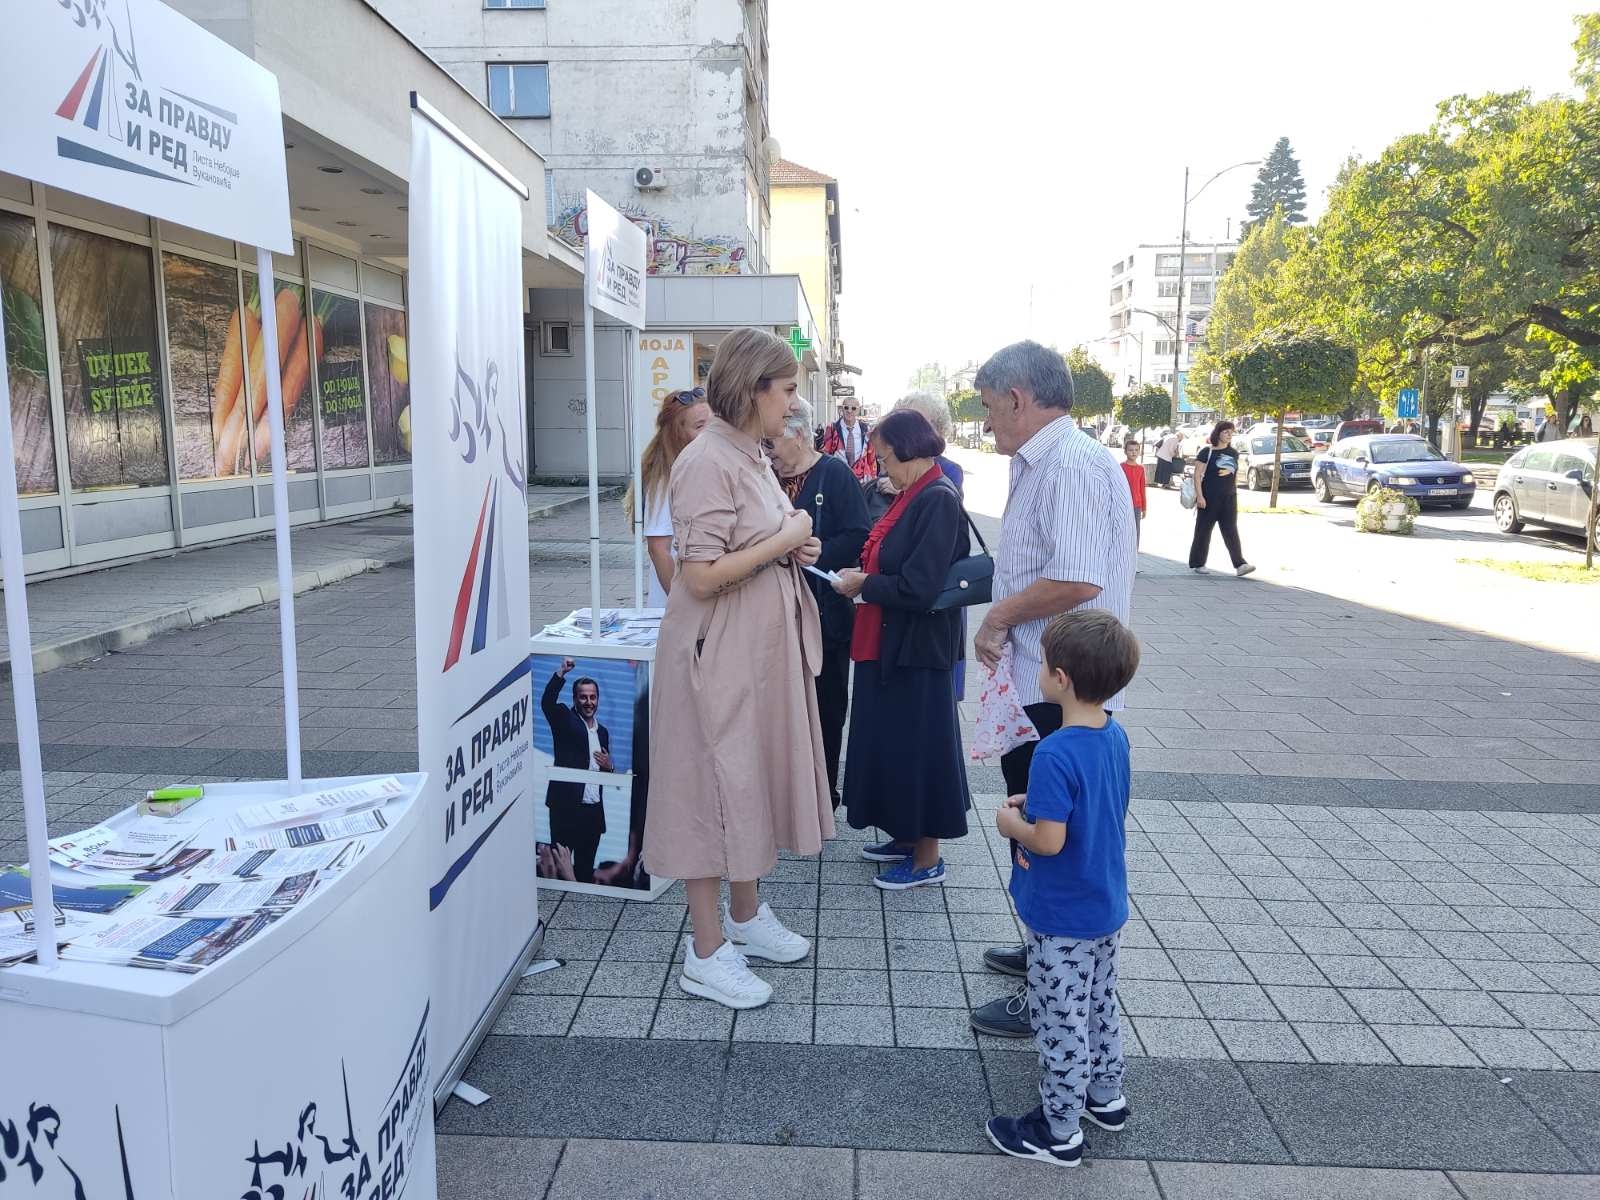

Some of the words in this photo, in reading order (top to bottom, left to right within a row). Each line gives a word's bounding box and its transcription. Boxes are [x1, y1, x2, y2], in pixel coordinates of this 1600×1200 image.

[125, 82, 152, 118] ЗА
[160, 97, 231, 152] ПРАВДУ
[127, 120, 141, 151] И
[149, 129, 187, 173] РЕД
[638, 338, 685, 351] MOJA
[445, 746, 465, 792] ЗА
[471, 695, 529, 770] ПРАВДУ
[445, 801, 456, 844] И
[462, 767, 494, 826] РЕД
[378, 1028, 428, 1165] ПРАВДУ
